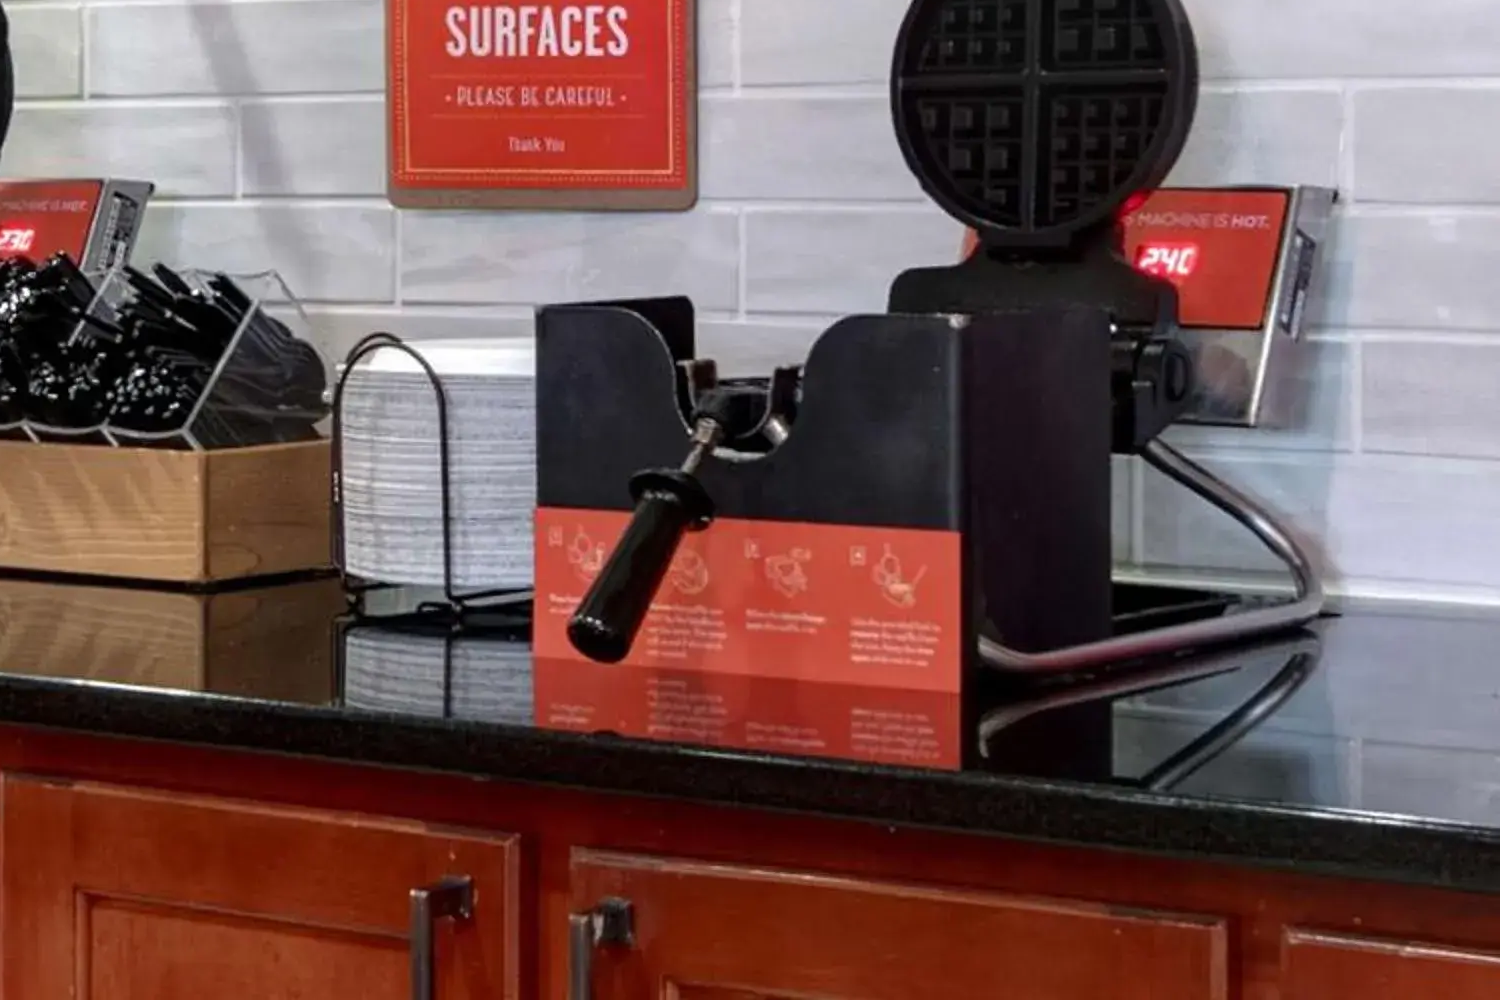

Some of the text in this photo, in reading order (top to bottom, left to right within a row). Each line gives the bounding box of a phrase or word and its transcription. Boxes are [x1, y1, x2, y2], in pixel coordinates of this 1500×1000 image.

[445, 5, 630, 59] SURFACES
[457, 86, 615, 107] PLEASE BE CAREFUL
[509, 136, 566, 153] Thank You
